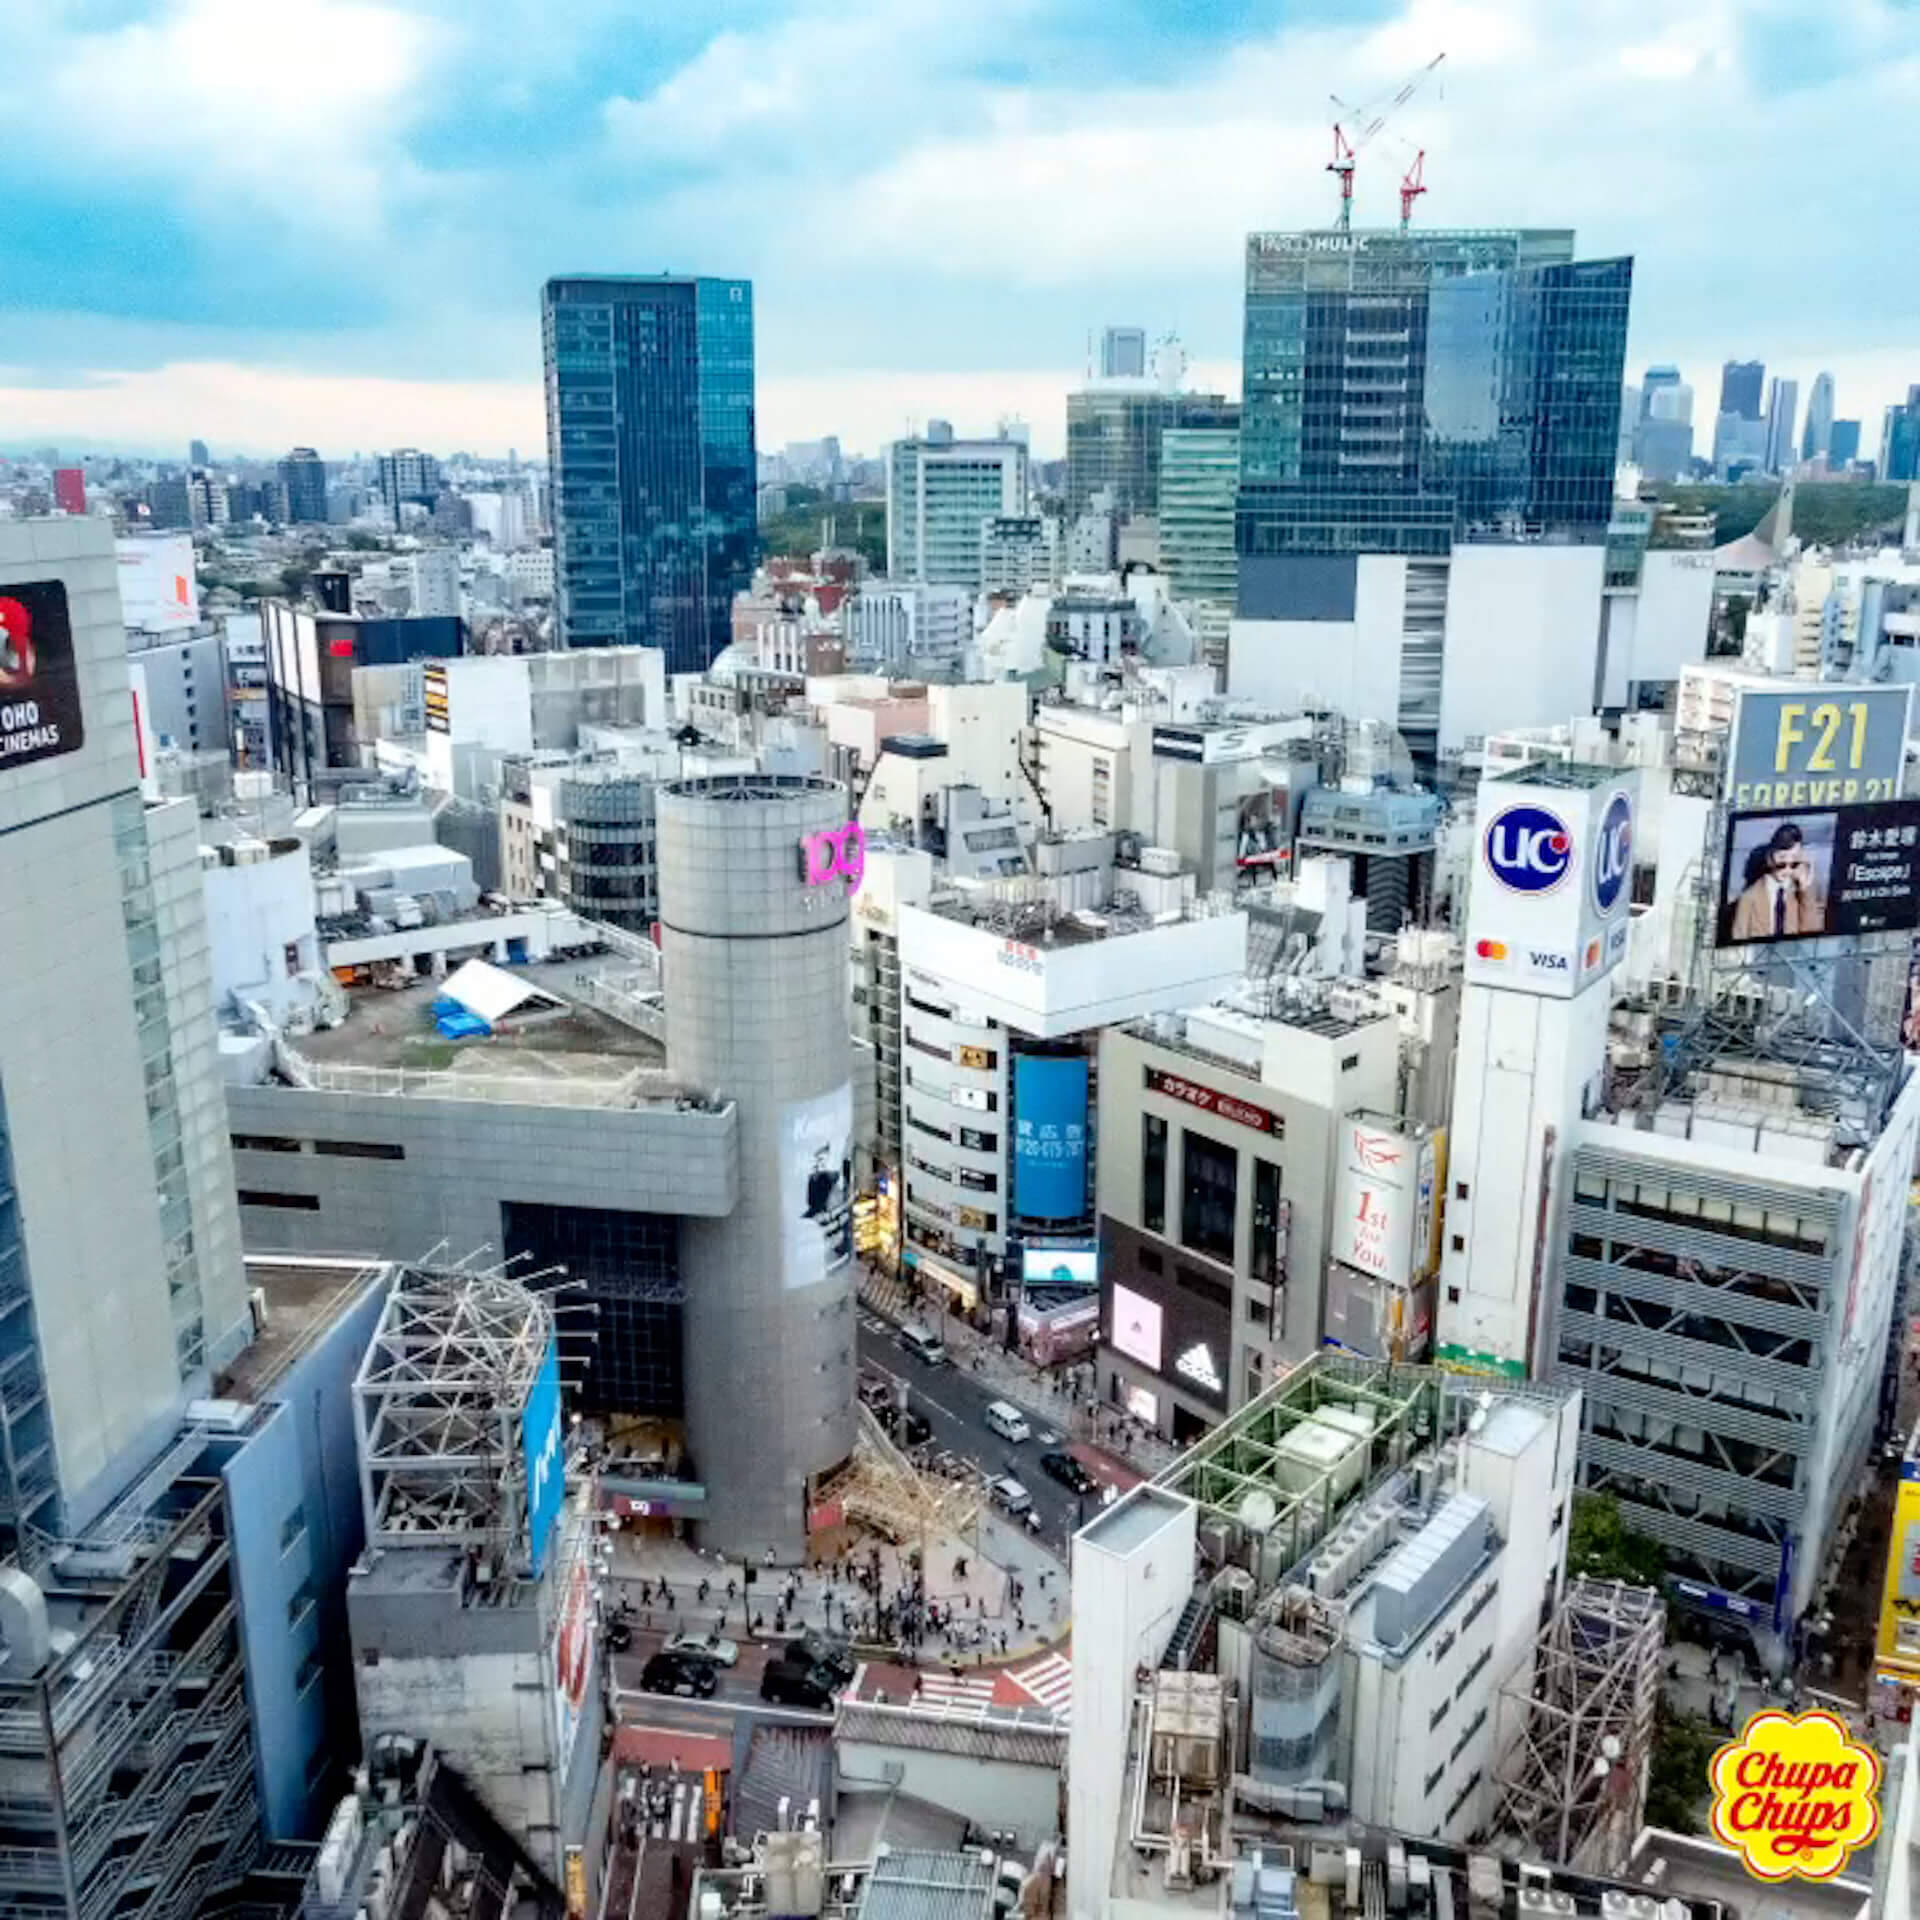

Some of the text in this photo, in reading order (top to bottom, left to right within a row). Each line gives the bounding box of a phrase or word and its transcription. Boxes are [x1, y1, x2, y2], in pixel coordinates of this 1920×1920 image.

[0, 700, 39, 731] OHO
[1775, 703, 1868, 773] F21
[1492, 825, 1569, 873] UC
[1530, 951, 1568, 970] VISA
